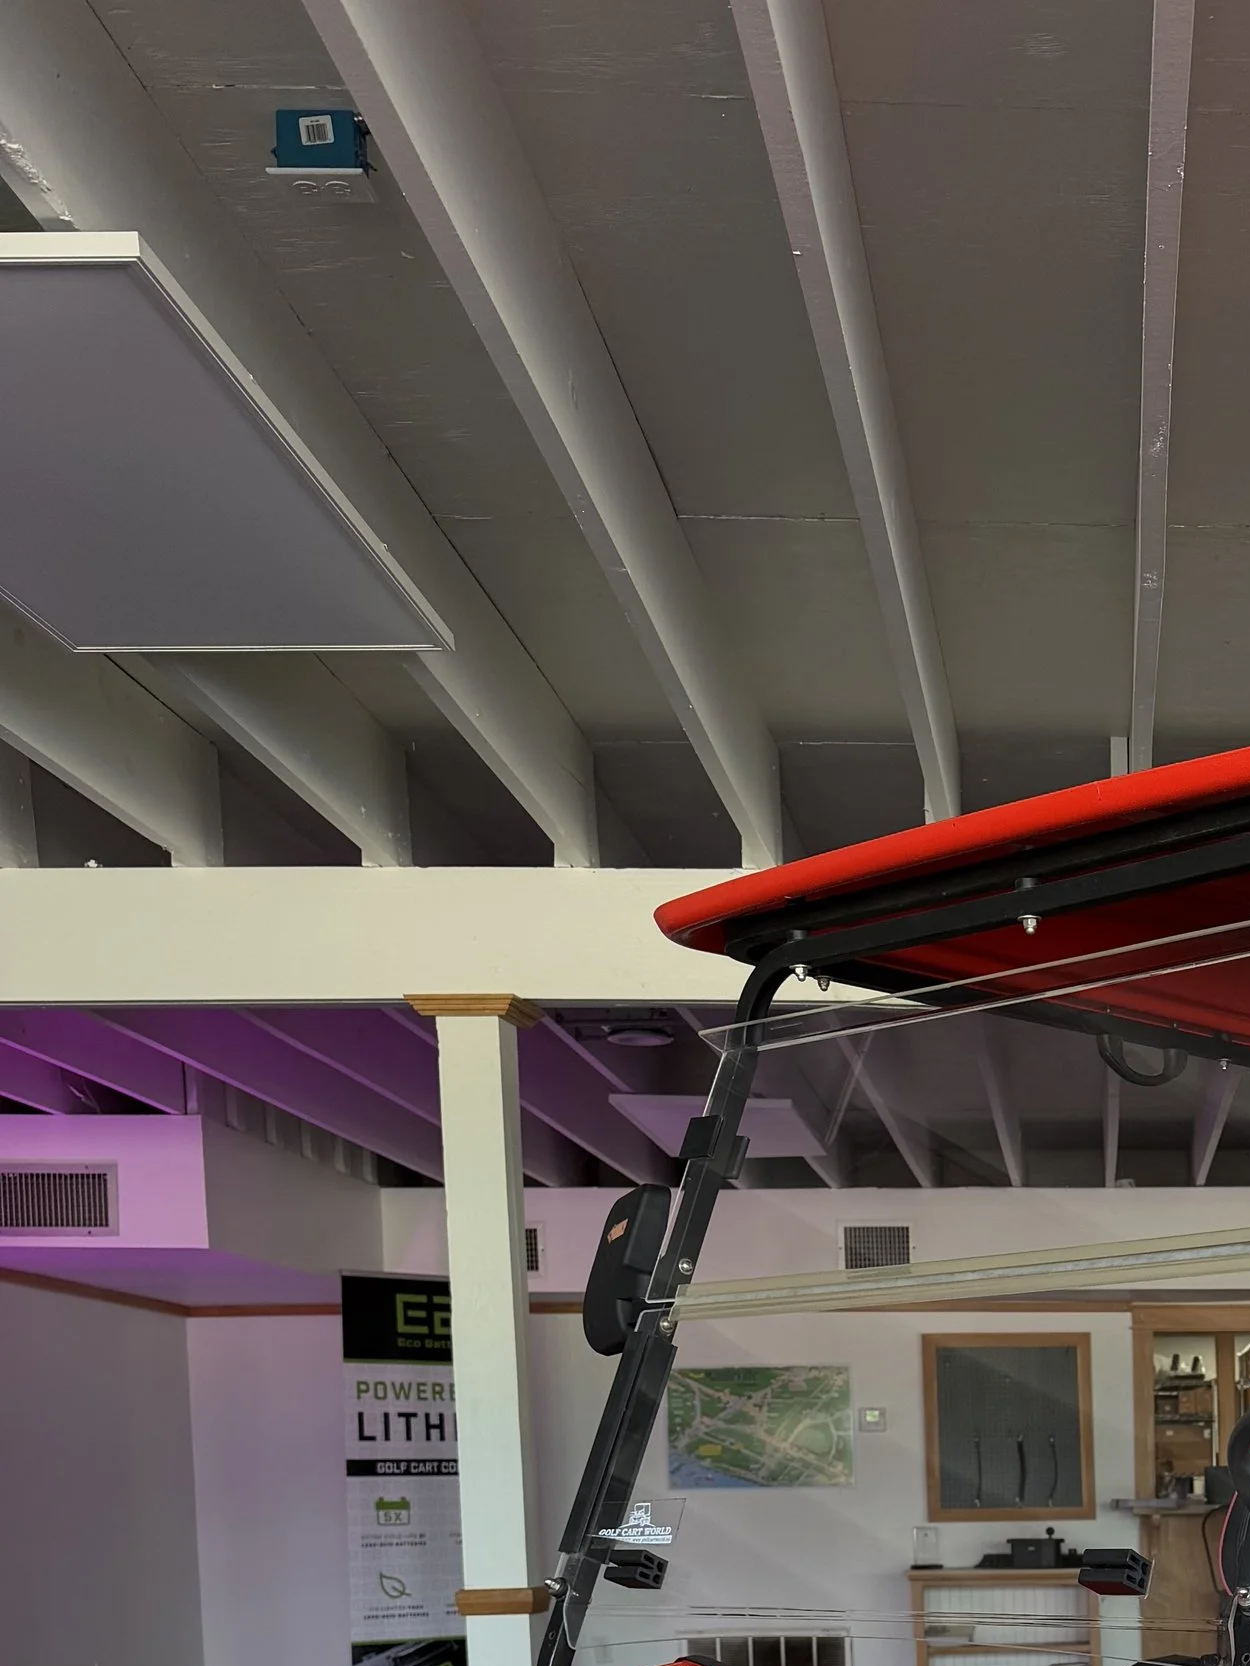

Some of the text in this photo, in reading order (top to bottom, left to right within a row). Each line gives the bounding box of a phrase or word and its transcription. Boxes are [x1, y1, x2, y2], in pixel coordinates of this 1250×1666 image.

[377, 1462, 407, 1473] GOLF
[411, 1462, 439, 1473] CART
[622, 1528, 643, 1536] CART
[644, 1526, 672, 1535] WORLD
